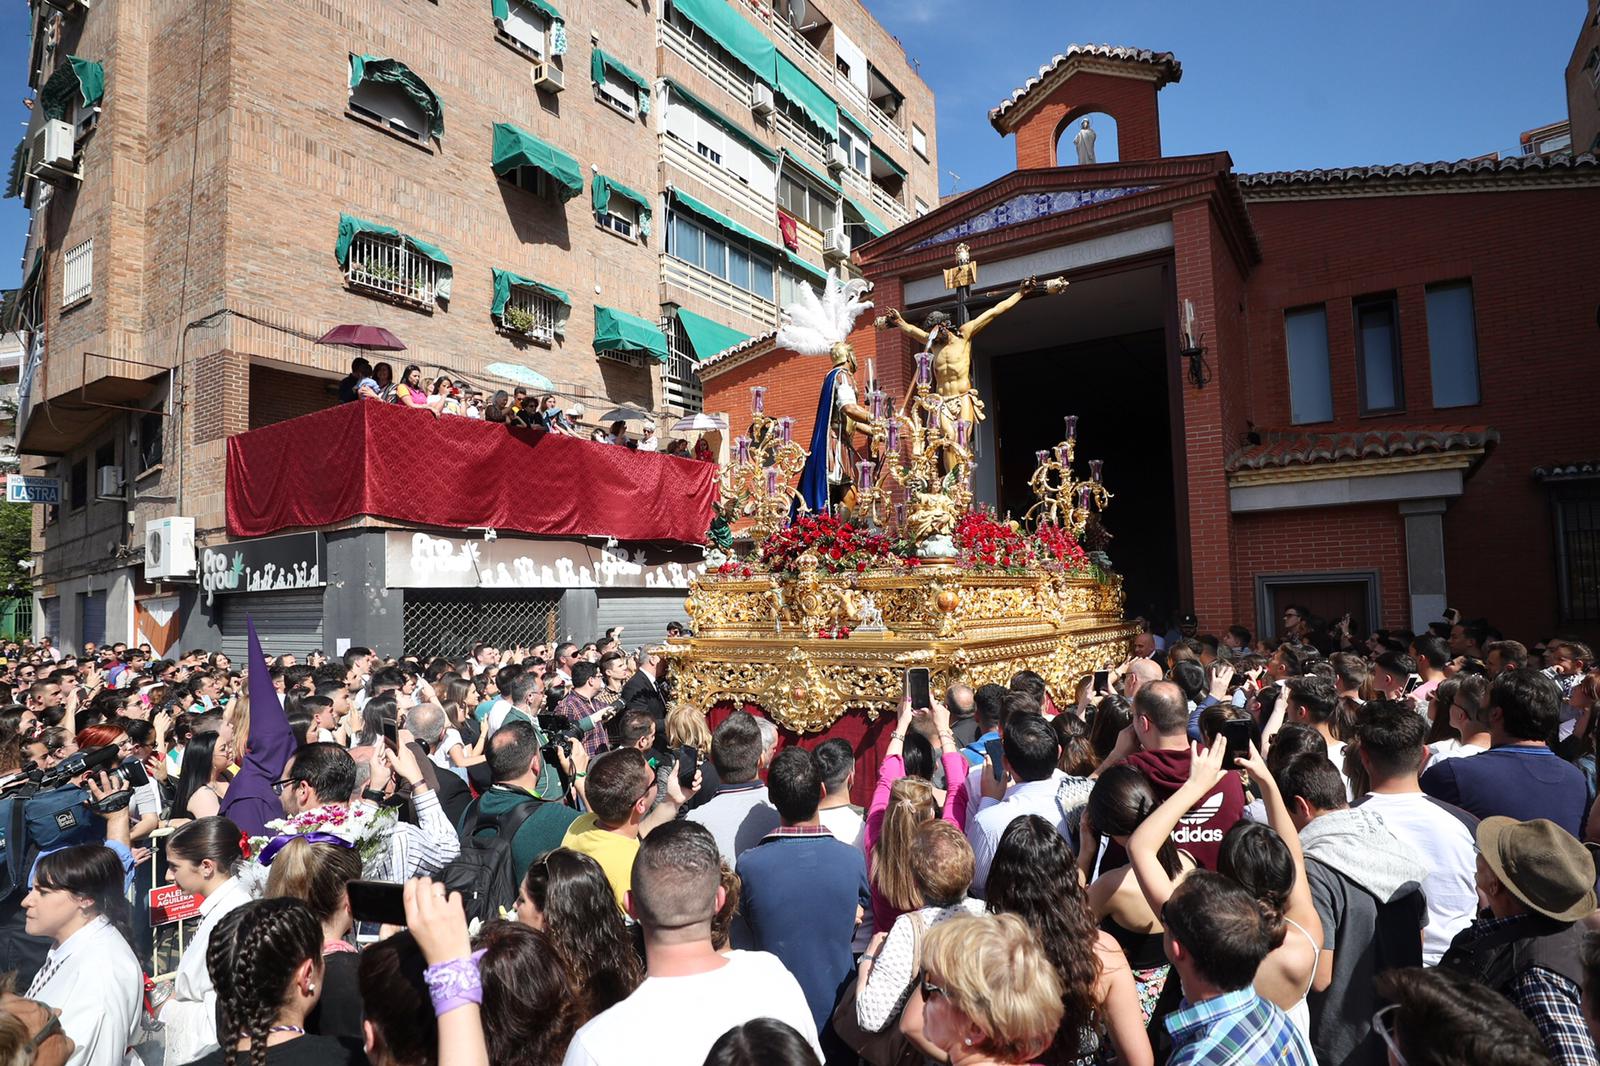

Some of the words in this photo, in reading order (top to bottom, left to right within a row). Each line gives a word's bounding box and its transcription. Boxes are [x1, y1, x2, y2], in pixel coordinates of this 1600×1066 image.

[13, 487, 57, 501] LASTRA
[204, 549, 228, 573] Pro
[203, 570, 239, 607] grow
